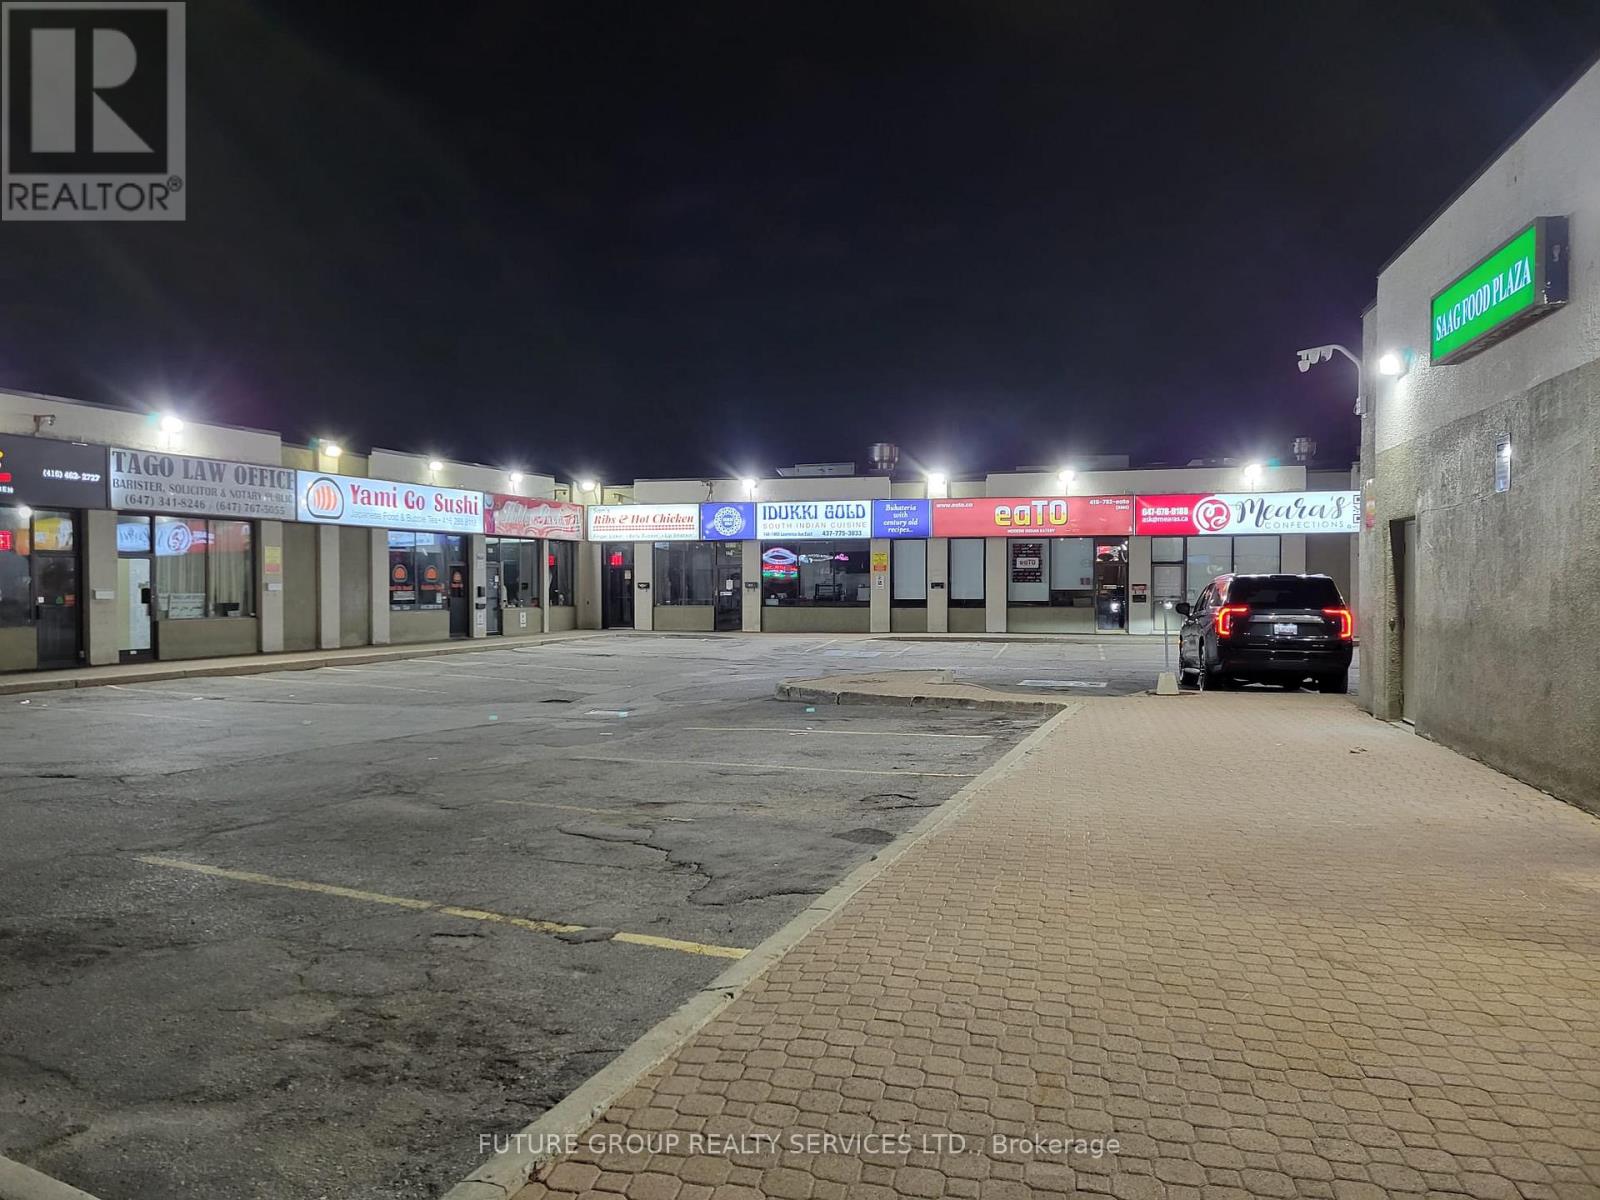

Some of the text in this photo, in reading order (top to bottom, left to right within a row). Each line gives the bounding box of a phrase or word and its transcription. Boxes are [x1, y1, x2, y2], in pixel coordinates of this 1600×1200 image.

[1435, 256, 1532, 341] SAAG FOOD PLAZA
[112, 451, 294, 490] TAGO LAW OFFICE
[112, 478, 166, 493] BARISTER,
[168, 483, 218, 497] SOLICITOR
[220, 487, 226, 498] &
[229, 489, 261, 501] NOTARY
[125, 493, 154, 508] (647)
[350, 483, 479, 516] Yami Go Sushi
[594, 514, 616, 525] Ribs
[631, 514, 650, 525] Hot
[652, 513, 694, 524] Chicken
[763, 503, 866, 521] IDUKKI GOLD
[893, 510, 909, 518] with
[994, 499, 1069, 527] eaTO
[1236, 496, 1351, 528] Meara's
[763, 521, 868, 530] SOUTH INDIAN CUISINE
[908, 518, 919, 527] old
[1264, 520, 1344, 530] CONFECTIONS
